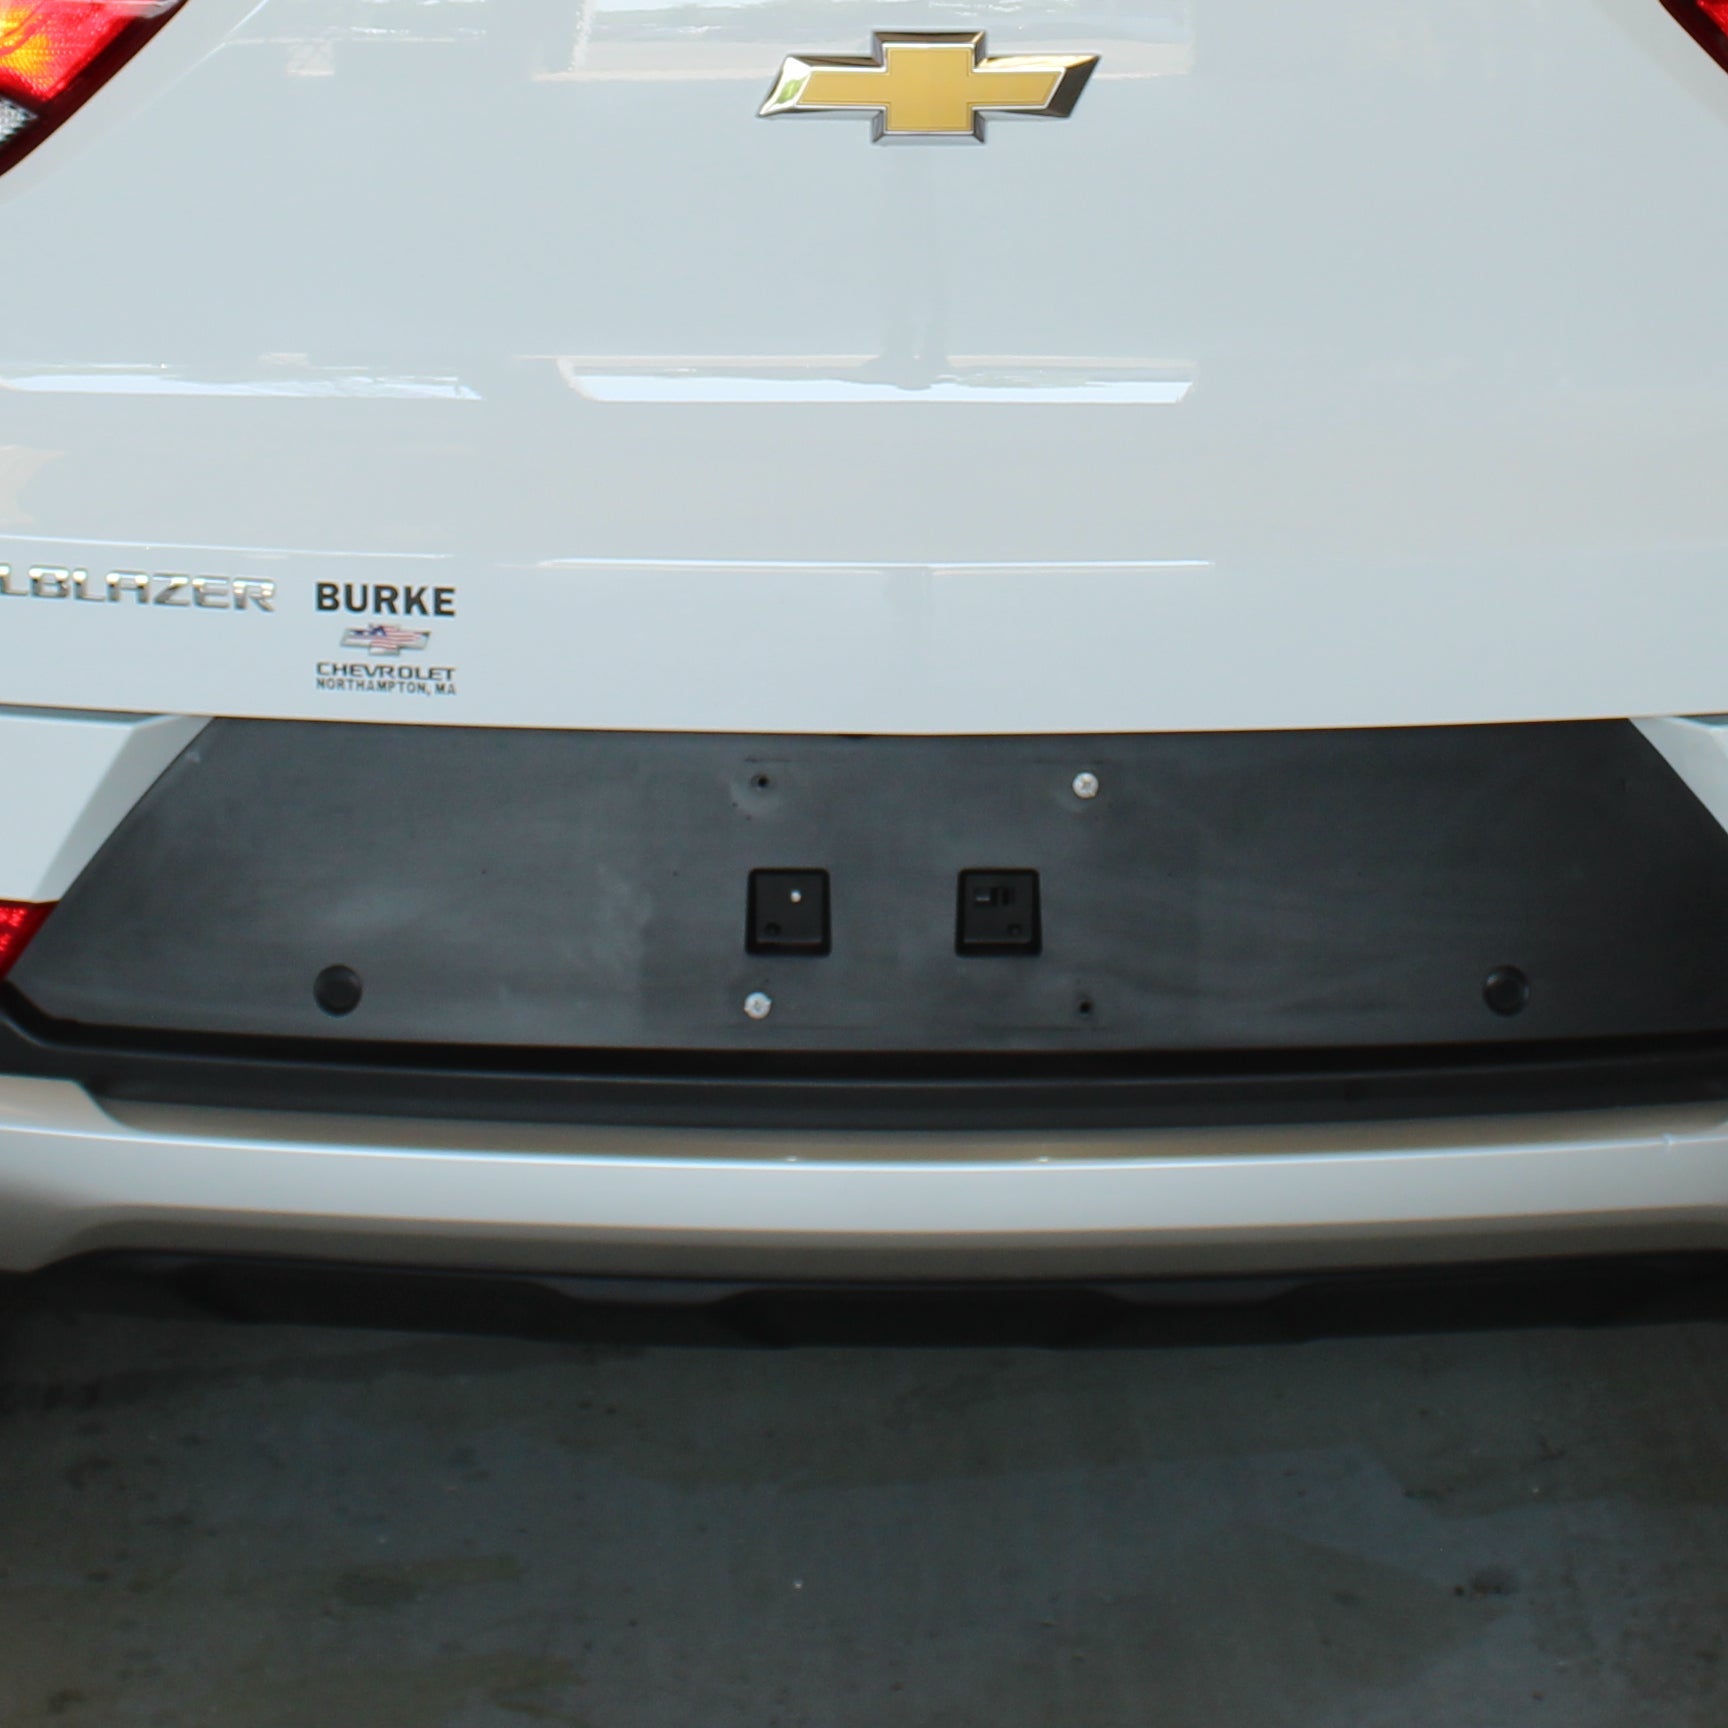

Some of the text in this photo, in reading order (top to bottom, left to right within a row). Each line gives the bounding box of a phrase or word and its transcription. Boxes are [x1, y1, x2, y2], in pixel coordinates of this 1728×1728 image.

[315, 581, 457, 617] BURKE
[315, 661, 457, 681] CHEVROLET
[315, 677, 457, 697] NORTHAMPTON, MA
